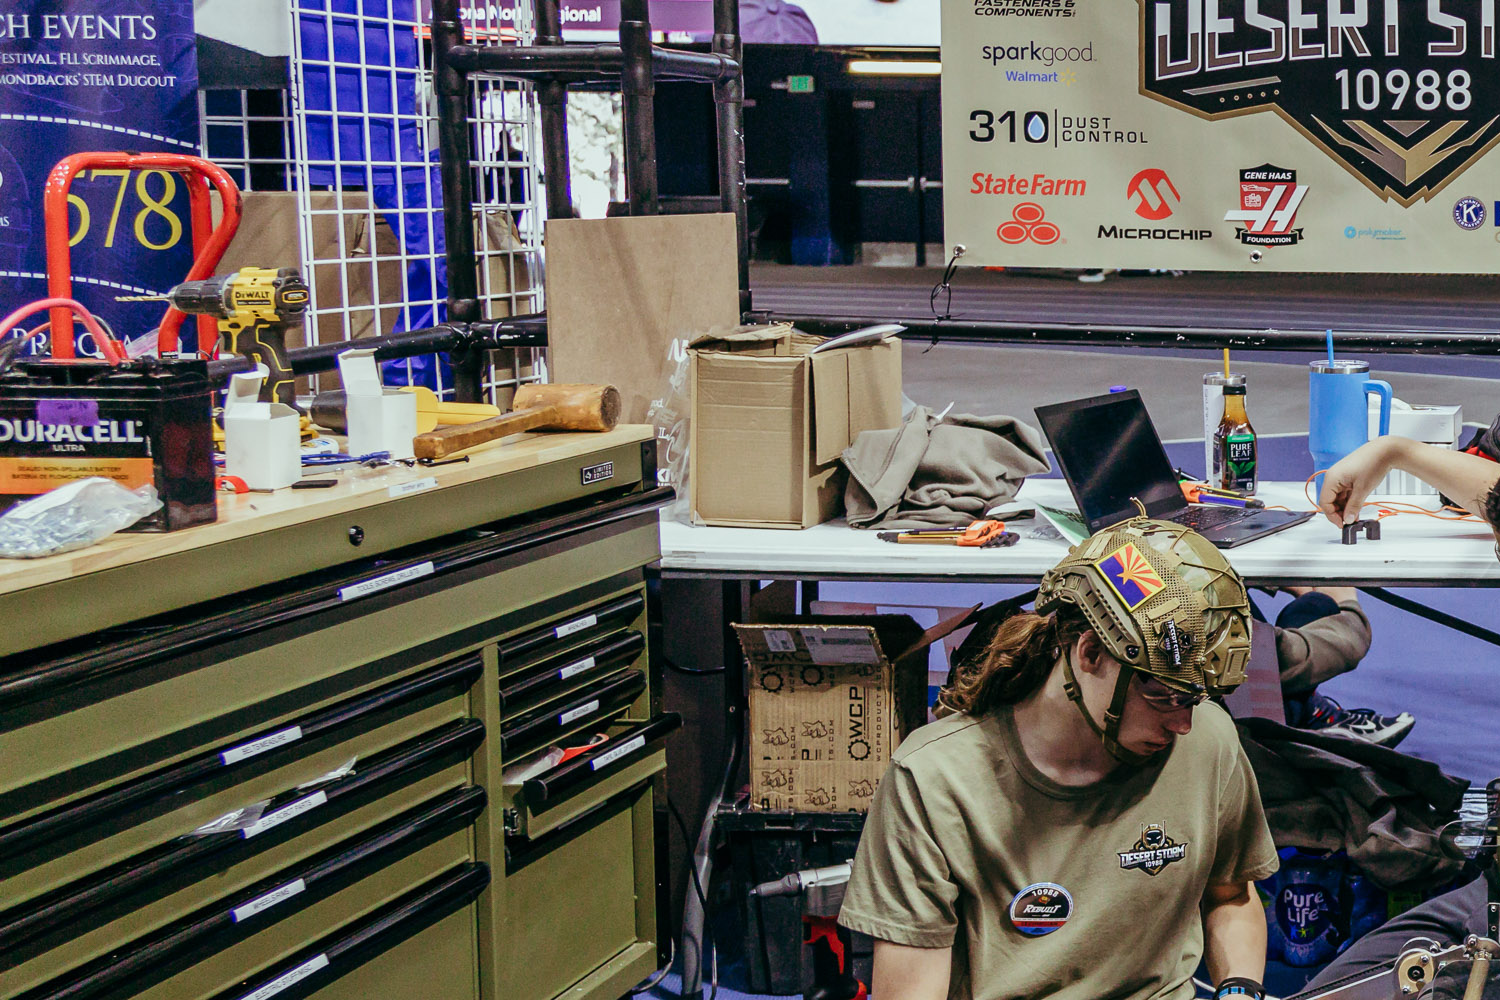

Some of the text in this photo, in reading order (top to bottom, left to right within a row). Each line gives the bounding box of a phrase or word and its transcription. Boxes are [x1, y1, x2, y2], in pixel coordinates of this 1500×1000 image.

[974, 8, 1072, 17] COMPONENTS
[43, 15, 157, 40] EVENTS
[1155, 0, 1399, 80] DESERT
[60, 53, 81, 65] FLL
[982, 41, 1094, 67] sparkgood
[84, 74, 115, 87] STEM
[118, 75, 177, 88] DUGOUT
[1005, 71, 1059, 83] Walmart
[1335, 68, 1473, 111] 10988
[969, 110, 1050, 144] 310
[1062, 116, 1112, 129] DUST
[1062, 130, 1149, 144] CONTROL
[1244, 171, 1293, 181] GENE HAAS
[1097, 224, 1213, 241] MICROCHIP
[1246, 236, 1292, 244] FOUNDATION
[0, 420, 144, 443] DURACELL
[52, 444, 86, 452] ULTRA
[1230, 442, 1252, 451] PURE
[1230, 450, 1252, 458] LEAF
[849, 686, 864, 739] WCP
[1121, 844, 1187, 867] DESERT STORM
[1145, 859, 1163, 868] 10988
[1032, 888, 1059, 898] 10988
[1284, 888, 1325, 908] Pure
[1287, 907, 1319, 928] Life
